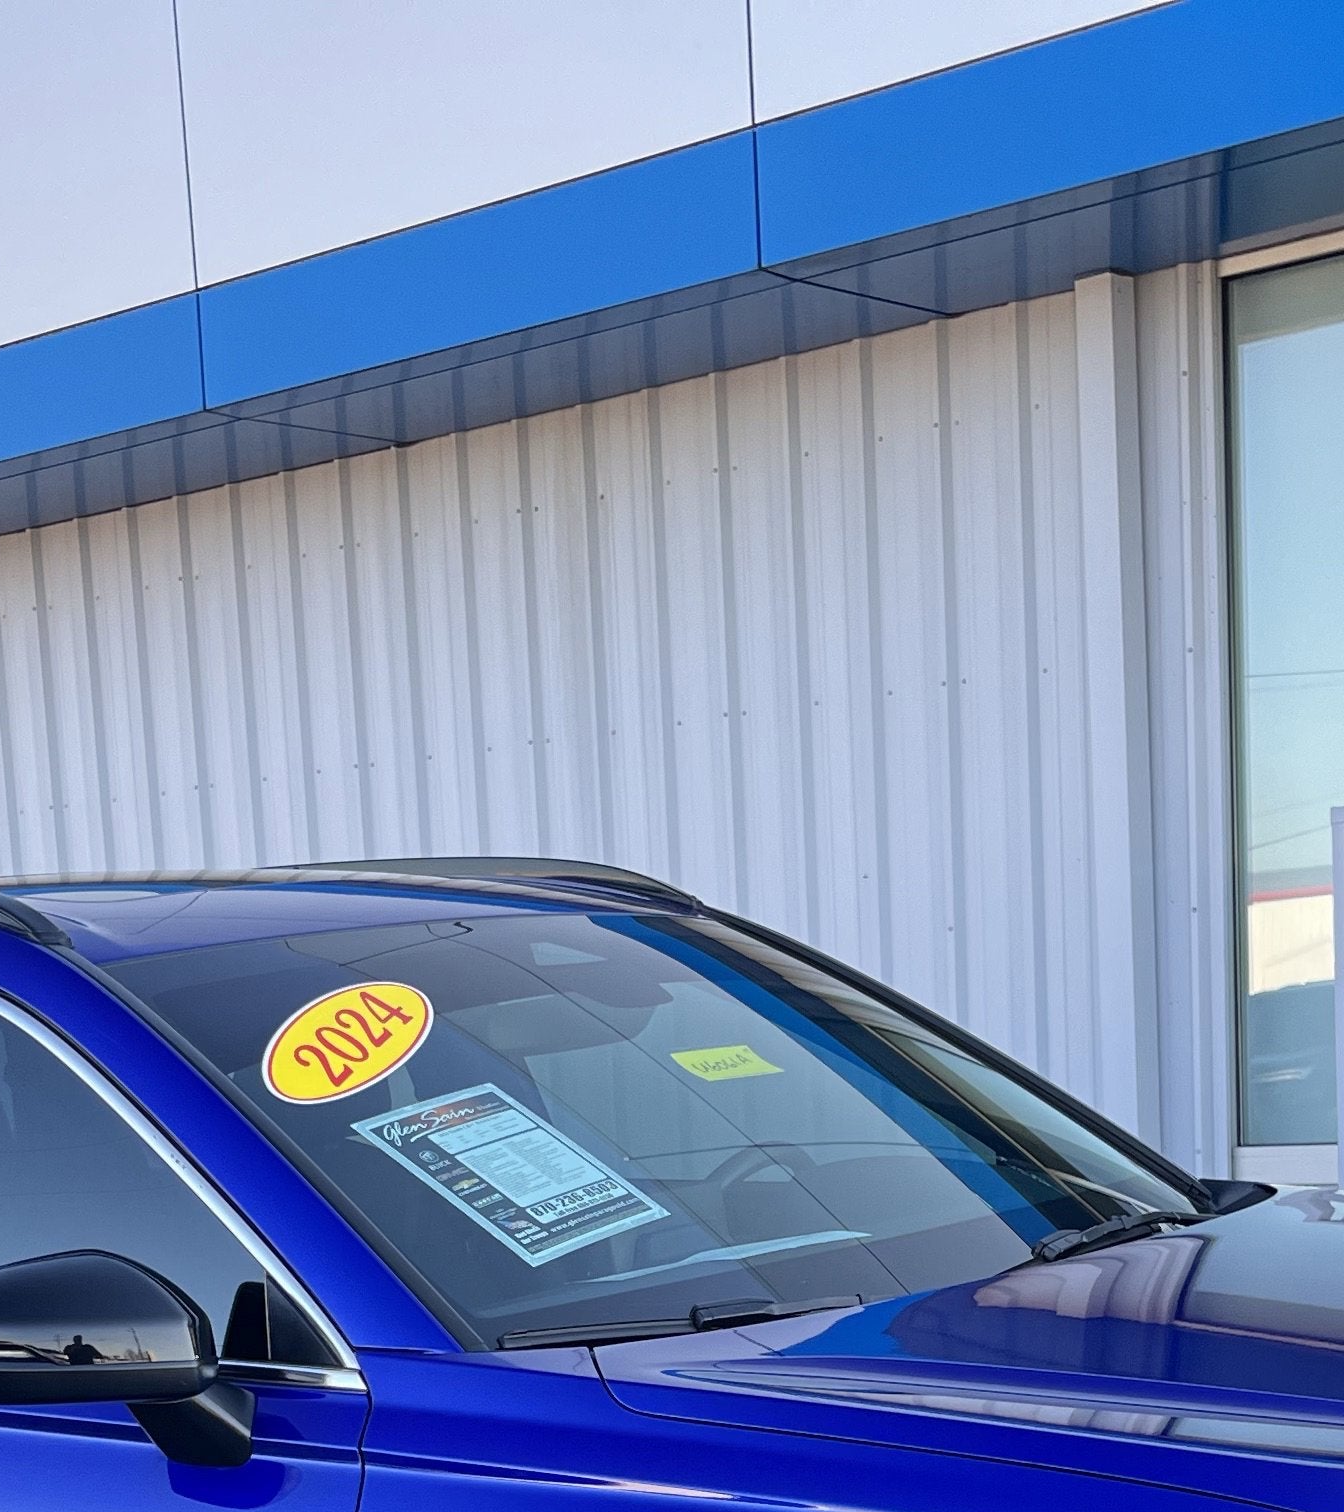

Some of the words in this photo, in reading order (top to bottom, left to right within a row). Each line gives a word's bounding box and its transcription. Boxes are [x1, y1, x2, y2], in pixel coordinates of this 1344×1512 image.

[293, 991, 414, 1087] 2024
[383, 1118, 427, 1147] Glen
[421, 1107, 474, 1128] Sain
